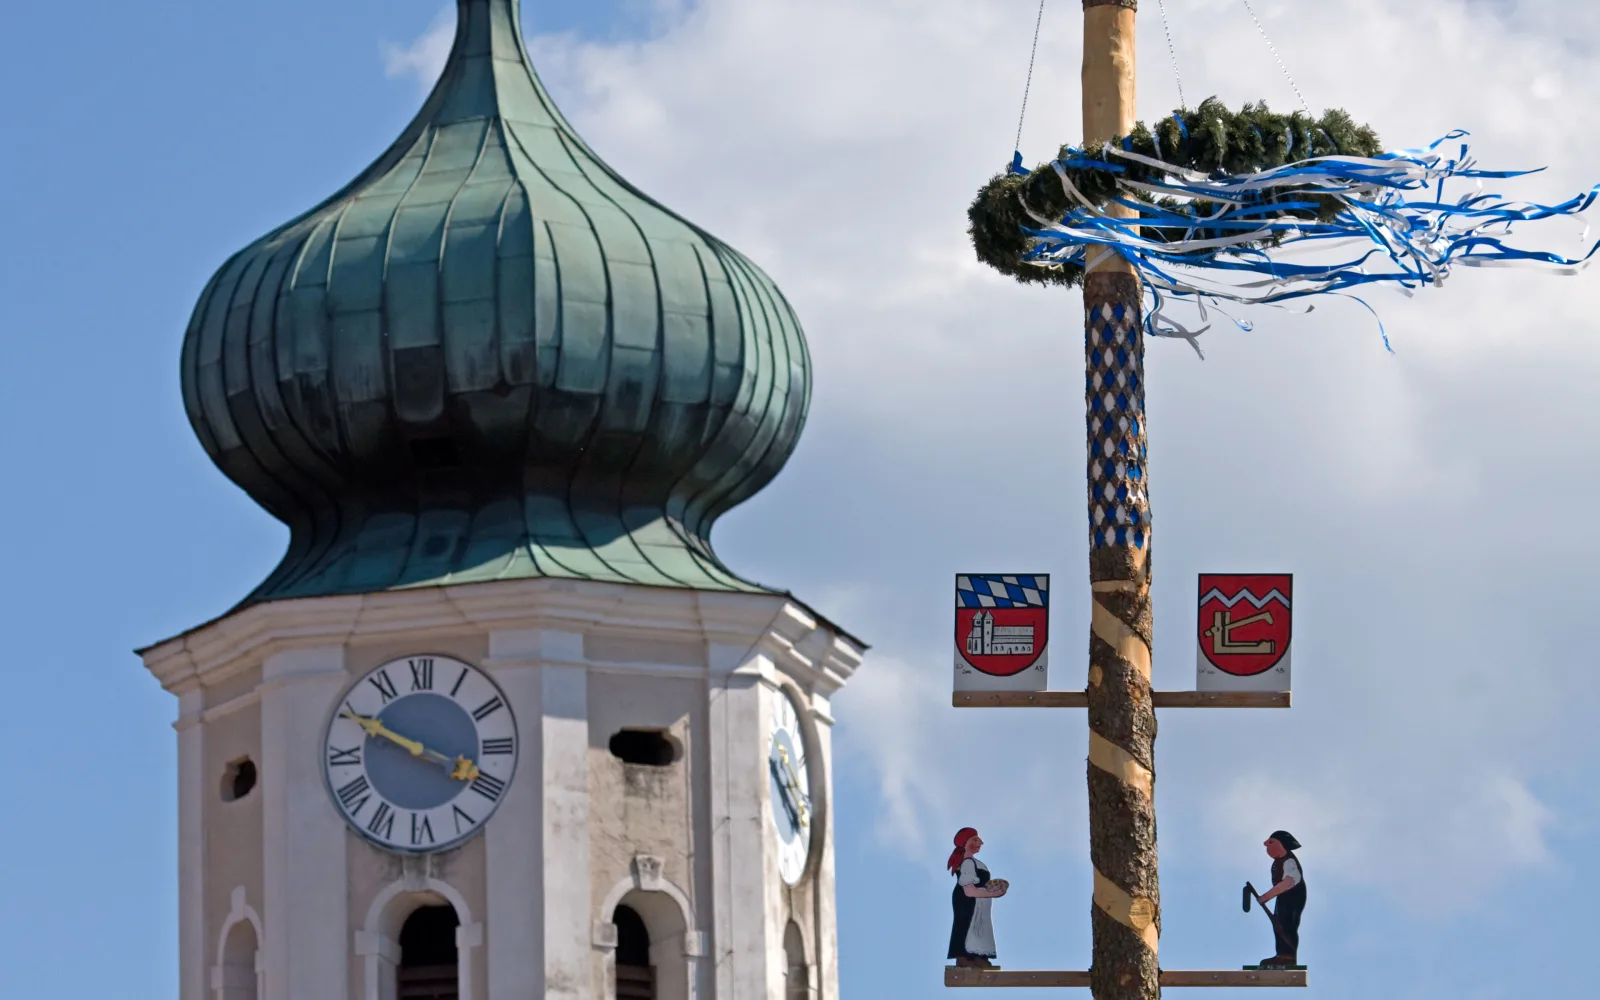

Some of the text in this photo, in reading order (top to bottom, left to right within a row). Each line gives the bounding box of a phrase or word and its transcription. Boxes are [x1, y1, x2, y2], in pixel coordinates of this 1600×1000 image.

[368, 669, 398, 704] XI
[408, 659, 434, 691] XII
[450, 667, 468, 697] I
[338, 701, 373, 731] X
[472, 696, 503, 722] II
[329, 746, 361, 766] IX
[482, 737, 513, 755] III
[337, 775, 371, 817] VIII
[367, 802, 395, 840] VII
[410, 812, 435, 845] VI
[452, 804, 476, 834] V
